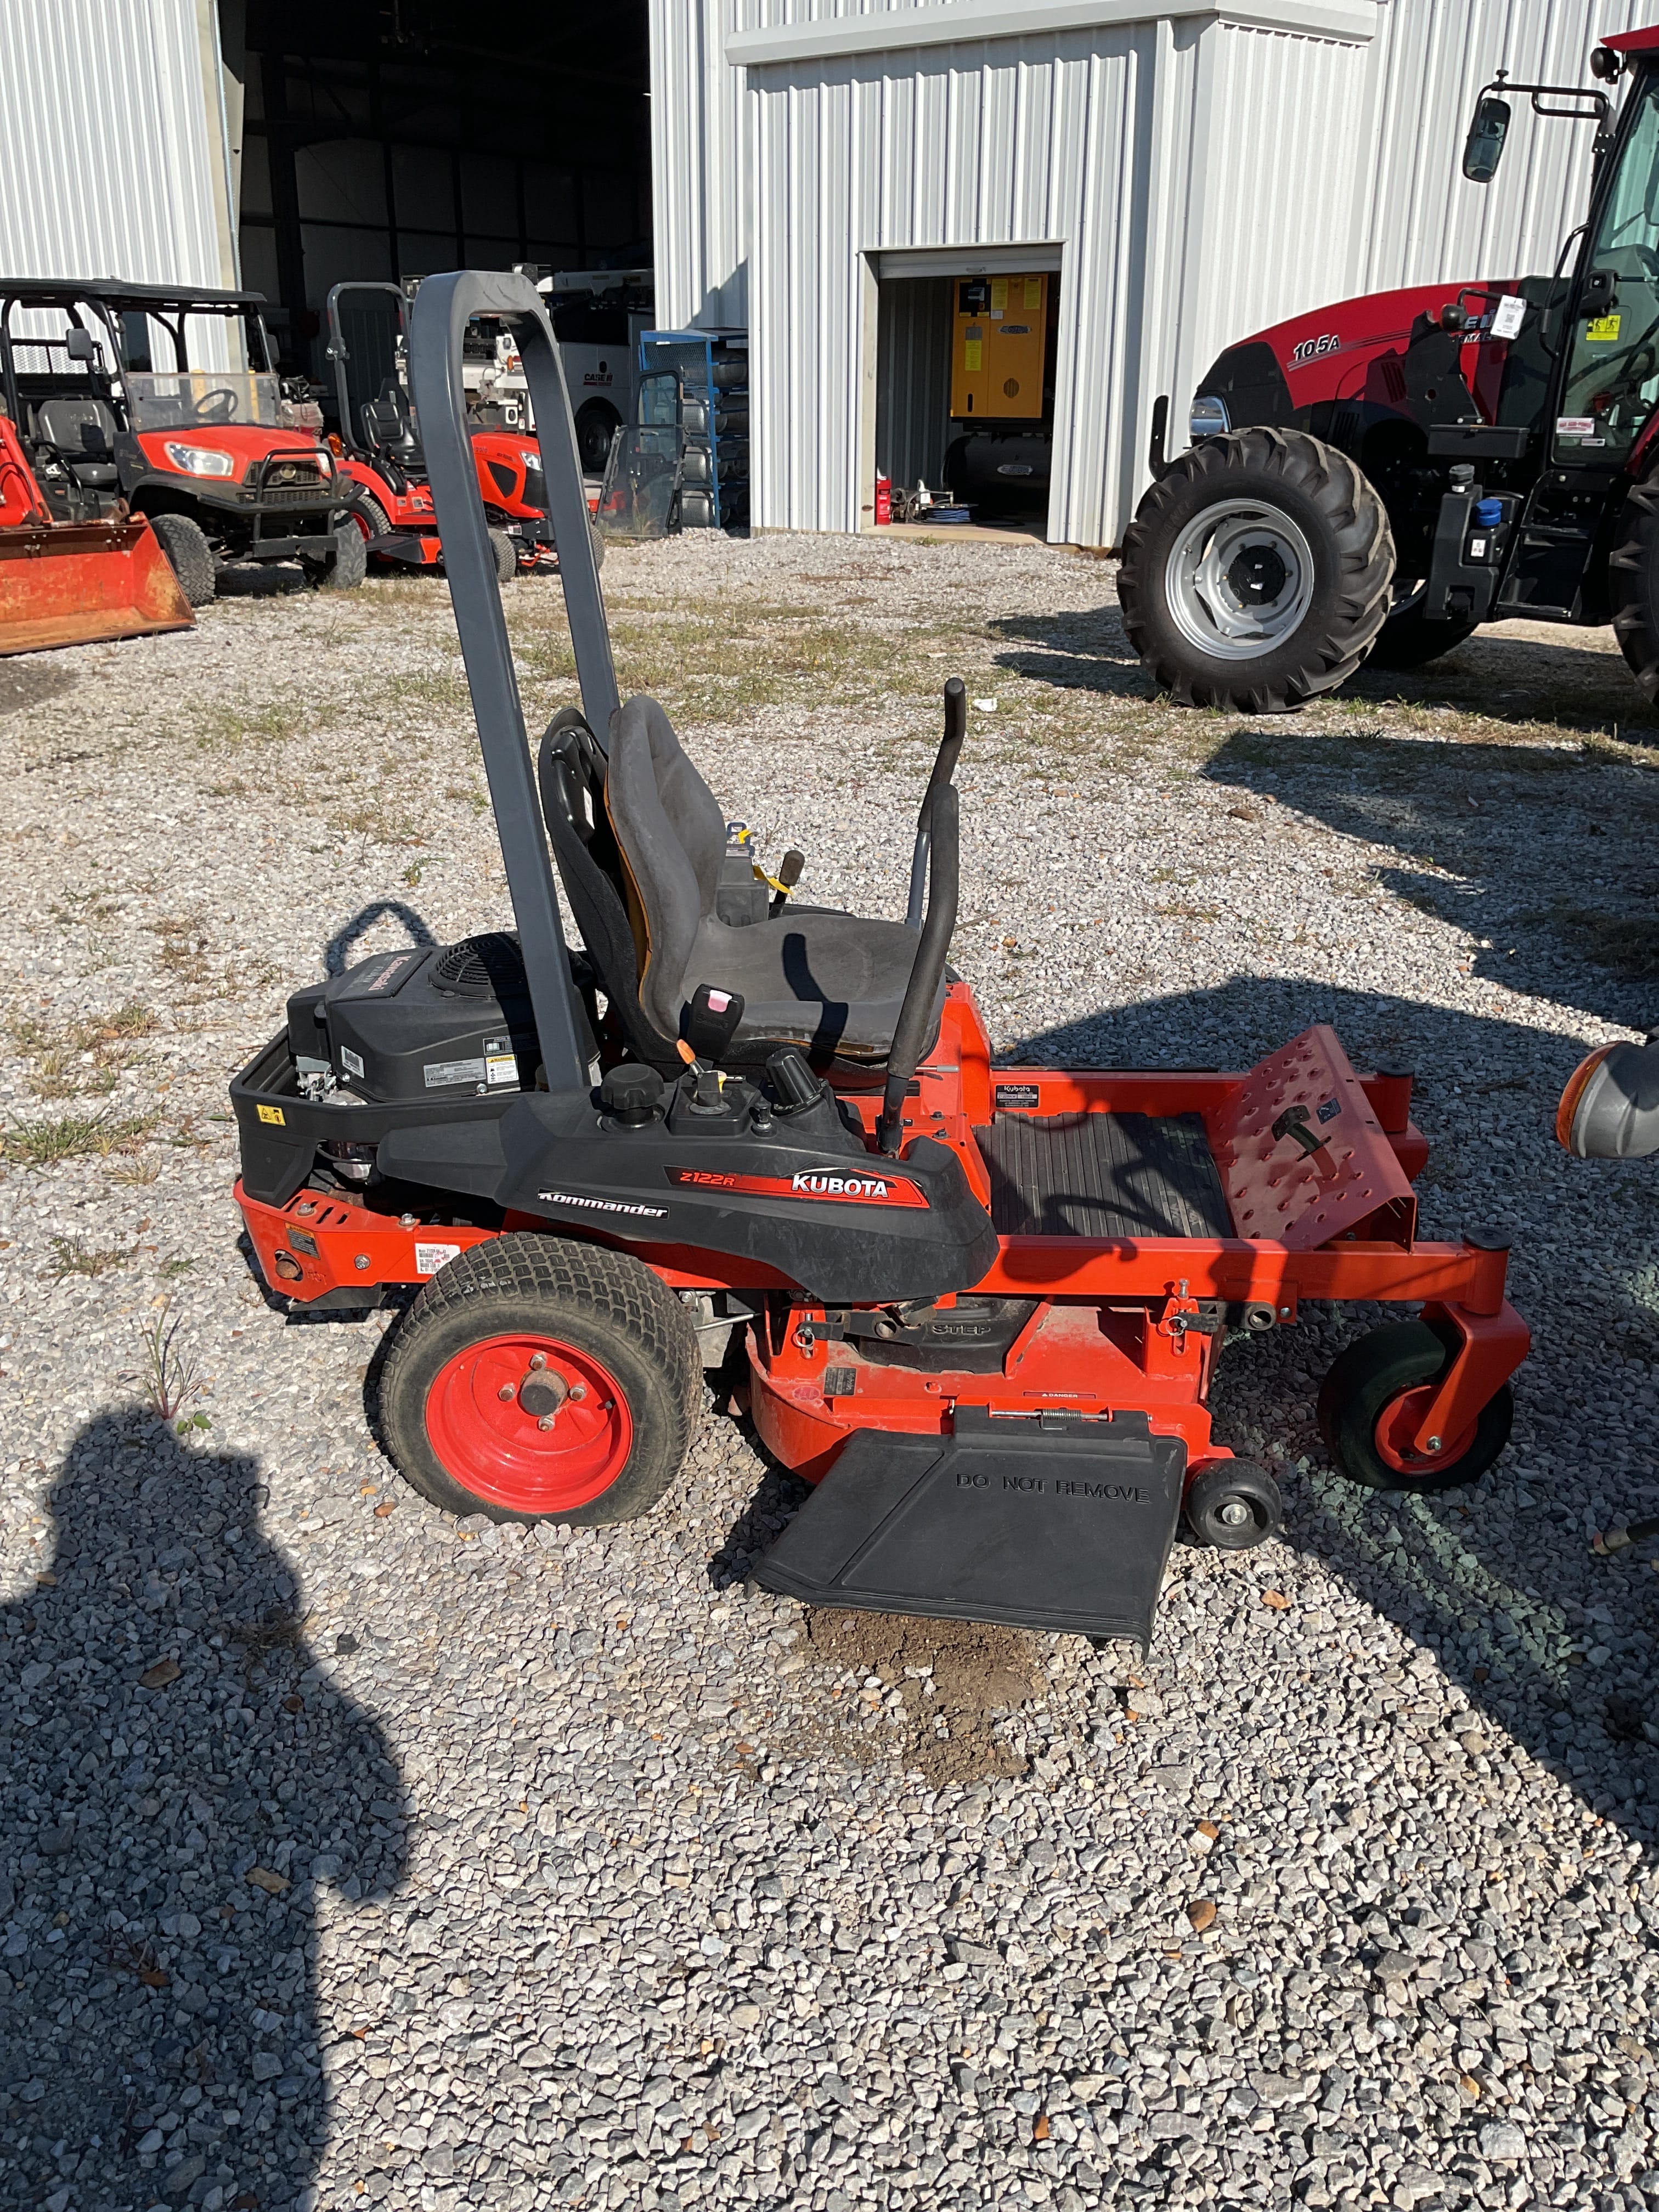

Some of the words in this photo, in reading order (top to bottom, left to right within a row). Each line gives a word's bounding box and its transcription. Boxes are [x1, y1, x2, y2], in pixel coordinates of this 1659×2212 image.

[1294, 334, 1341, 361] 105A
[368, 955, 412, 991] Kawasaki
[680, 1171, 735, 1187] Z122R
[792, 1175, 889, 1198] KUBOTA
[538, 1193, 668, 1217] Kommander
[933, 1324, 991, 1335] STEP
[956, 1474, 990, 1488] DO
[1003, 1476, 1048, 1493] NOT
[1056, 1480, 1150, 1504] REMOVE
